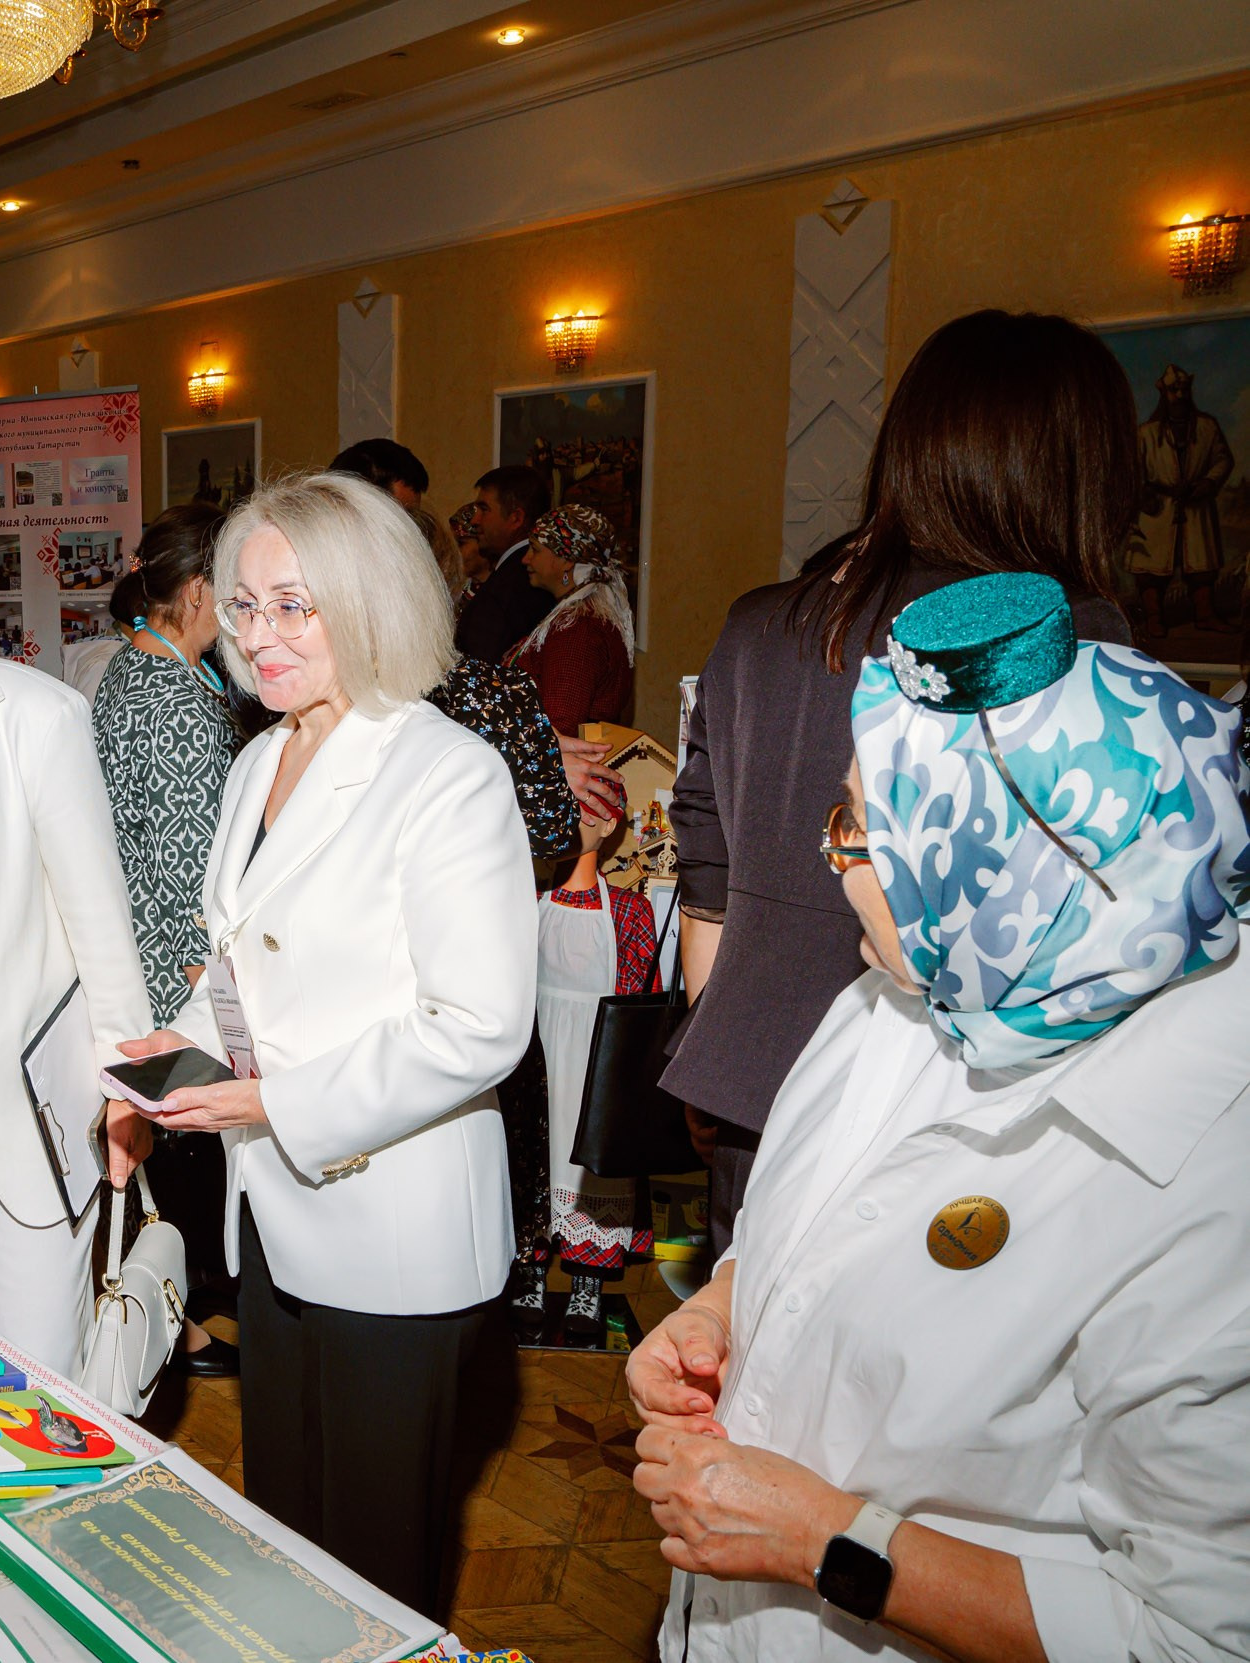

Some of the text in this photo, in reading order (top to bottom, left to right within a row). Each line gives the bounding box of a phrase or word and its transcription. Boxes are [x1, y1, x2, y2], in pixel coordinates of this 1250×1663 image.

[37, 440, 81, 451] Татарстан
[85, 468, 115, 479] Гранты
[23, 515, 109, 527] деятельность
[934, 1218, 979, 1262] Гармония
[80, 1520, 100, 1536] на
[123, 1497, 232, 1578] школа Гармония
[98, 1533, 183, 1604] деятельность
[119, 1532, 299, 1663] уроках татарского языка
